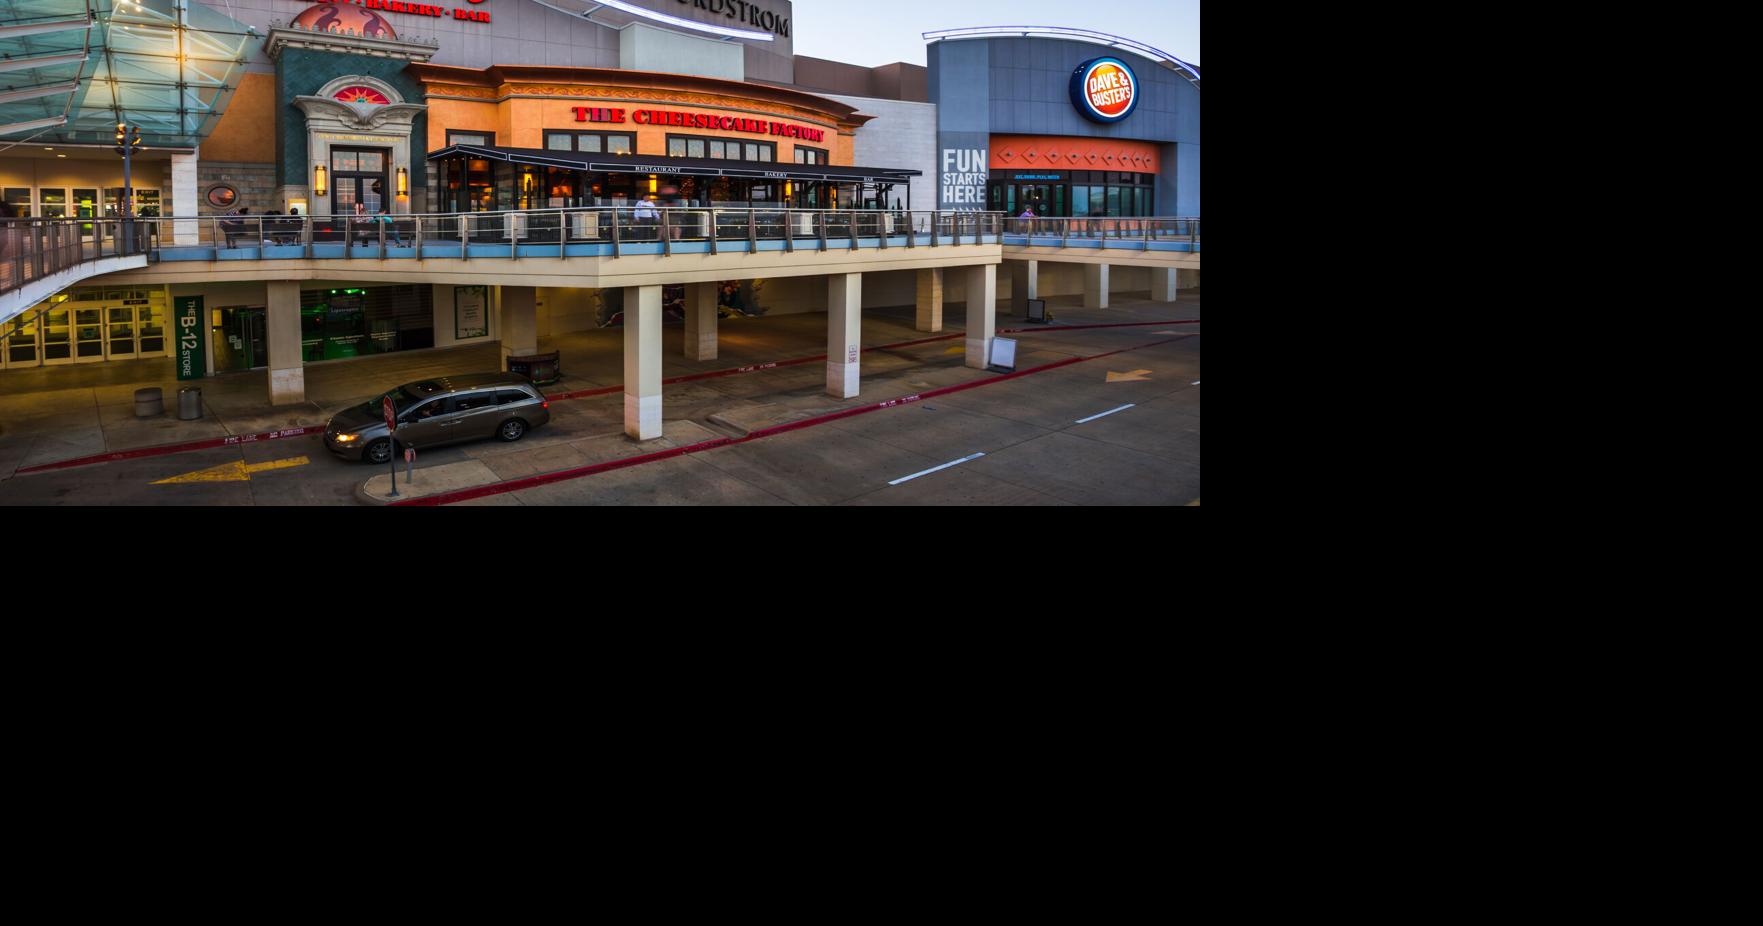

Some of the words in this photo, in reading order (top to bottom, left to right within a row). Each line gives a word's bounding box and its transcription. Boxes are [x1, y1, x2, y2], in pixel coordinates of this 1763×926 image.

[366, 0, 443, 17] BAKERY
[454, 8, 491, 23] BAR
[676, 0, 789, 38] DSTROM
[1090, 72, 1120, 93] DAVE
[1118, 72, 1129, 87] &
[1091, 86, 1130, 106] BUSTER'S
[572, 106, 626, 124] THE
[632, 109, 768, 134] CHEESECAKE
[769, 121, 825, 142] FACTORY
[635, 165, 680, 173] RESTAURANT
[943, 149, 986, 172] FUN
[943, 173, 986, 186] STARTS
[943, 185, 986, 203] HERE
[187, 301, 196, 317] THE
[181, 316, 198, 350] B-12
[182, 350, 191, 376] STORE
